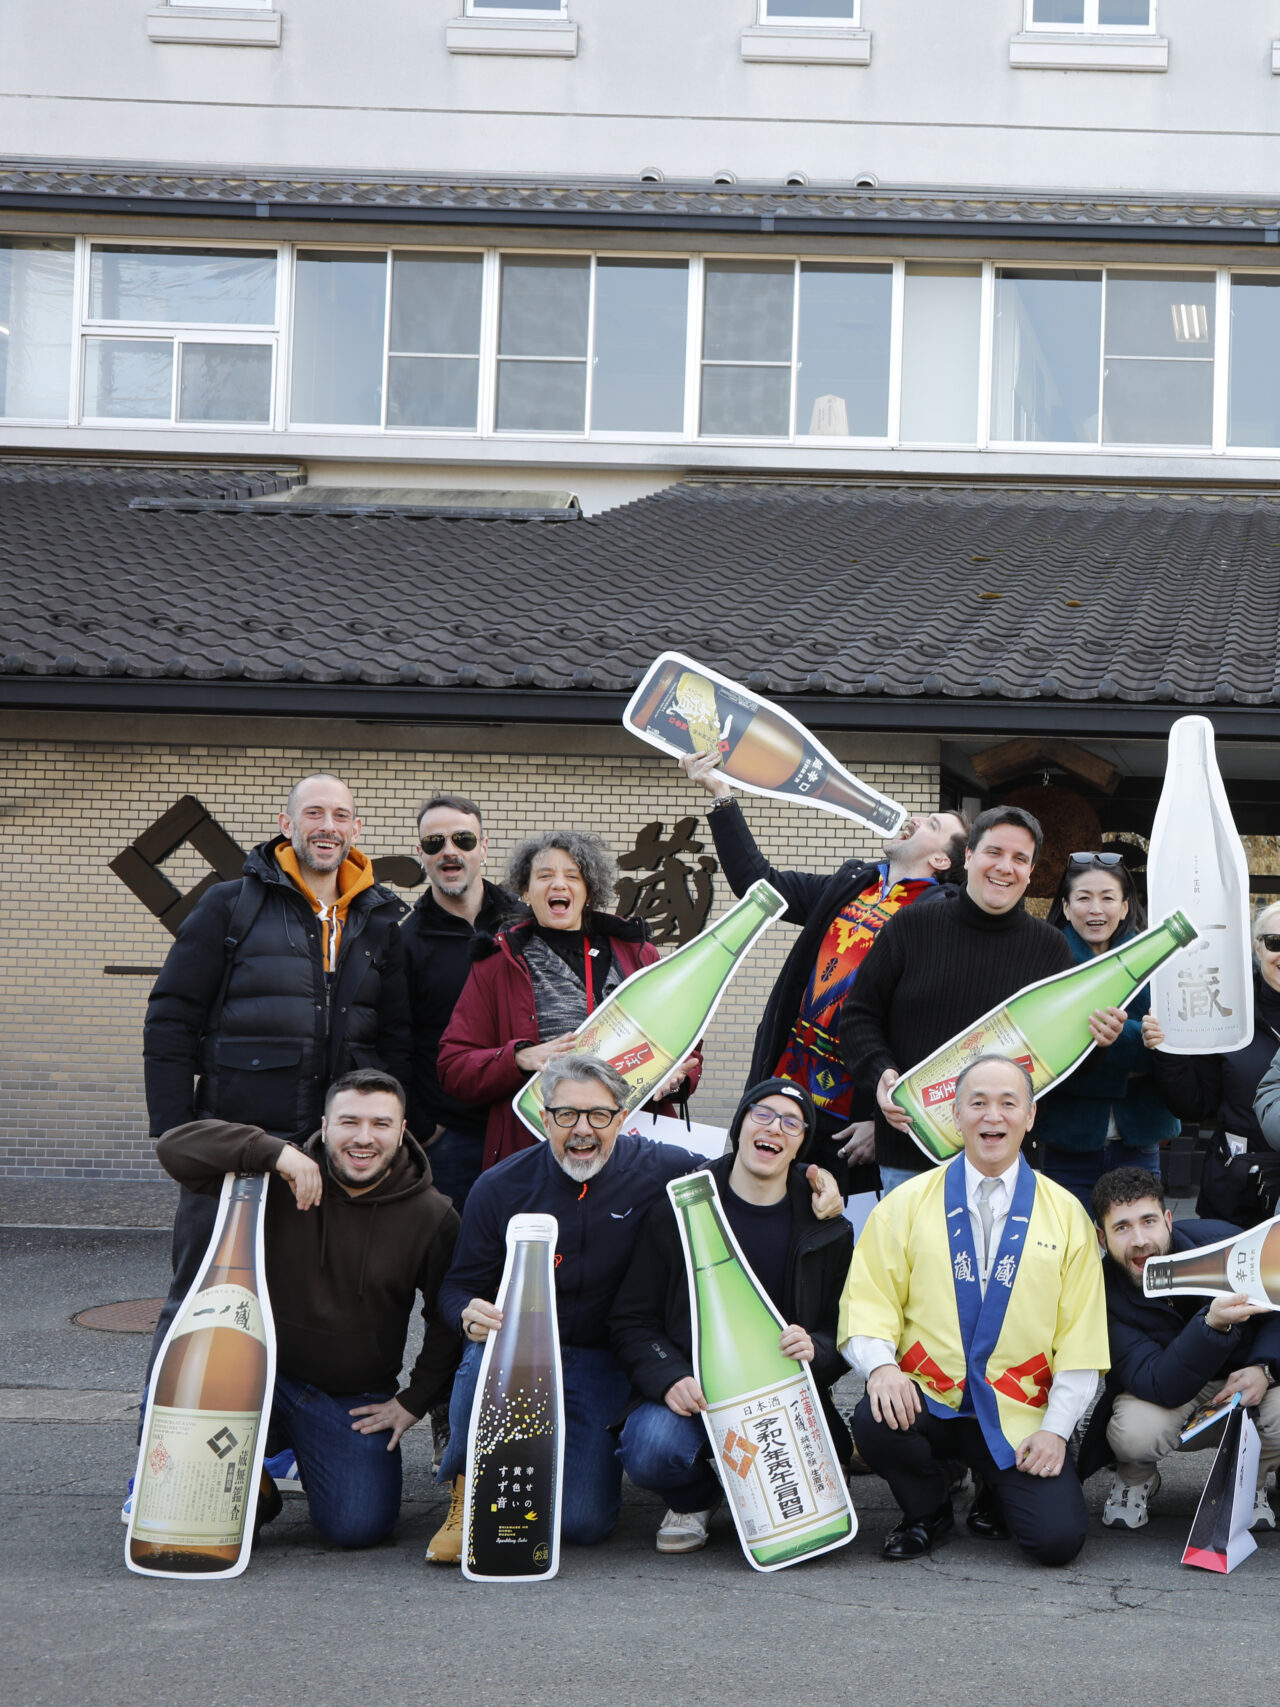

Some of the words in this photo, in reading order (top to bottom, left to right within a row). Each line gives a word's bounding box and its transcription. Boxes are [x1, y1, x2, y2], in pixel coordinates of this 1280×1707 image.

[666, 695, 733, 740] 一ノ蔵
[947, 1207, 976, 1283] 一ノ蔵
[993, 1215, 1030, 1288] 一ノ蔵
[1235, 1251, 1248, 1283] 辛口
[193, 1301, 251, 1332] 一ノ蔵
[743, 1396, 781, 1416] 日本酒
[799, 1388, 824, 1454] 立春朝搾り
[752, 1416, 804, 1520] 令和八年丙午二月四日
[800, 1436, 817, 1466] 純米吟醸
[495, 1465, 508, 1508] すず音
[511, 1465, 522, 1507] 黄色い
[523, 1465, 534, 1508] 幸せの
